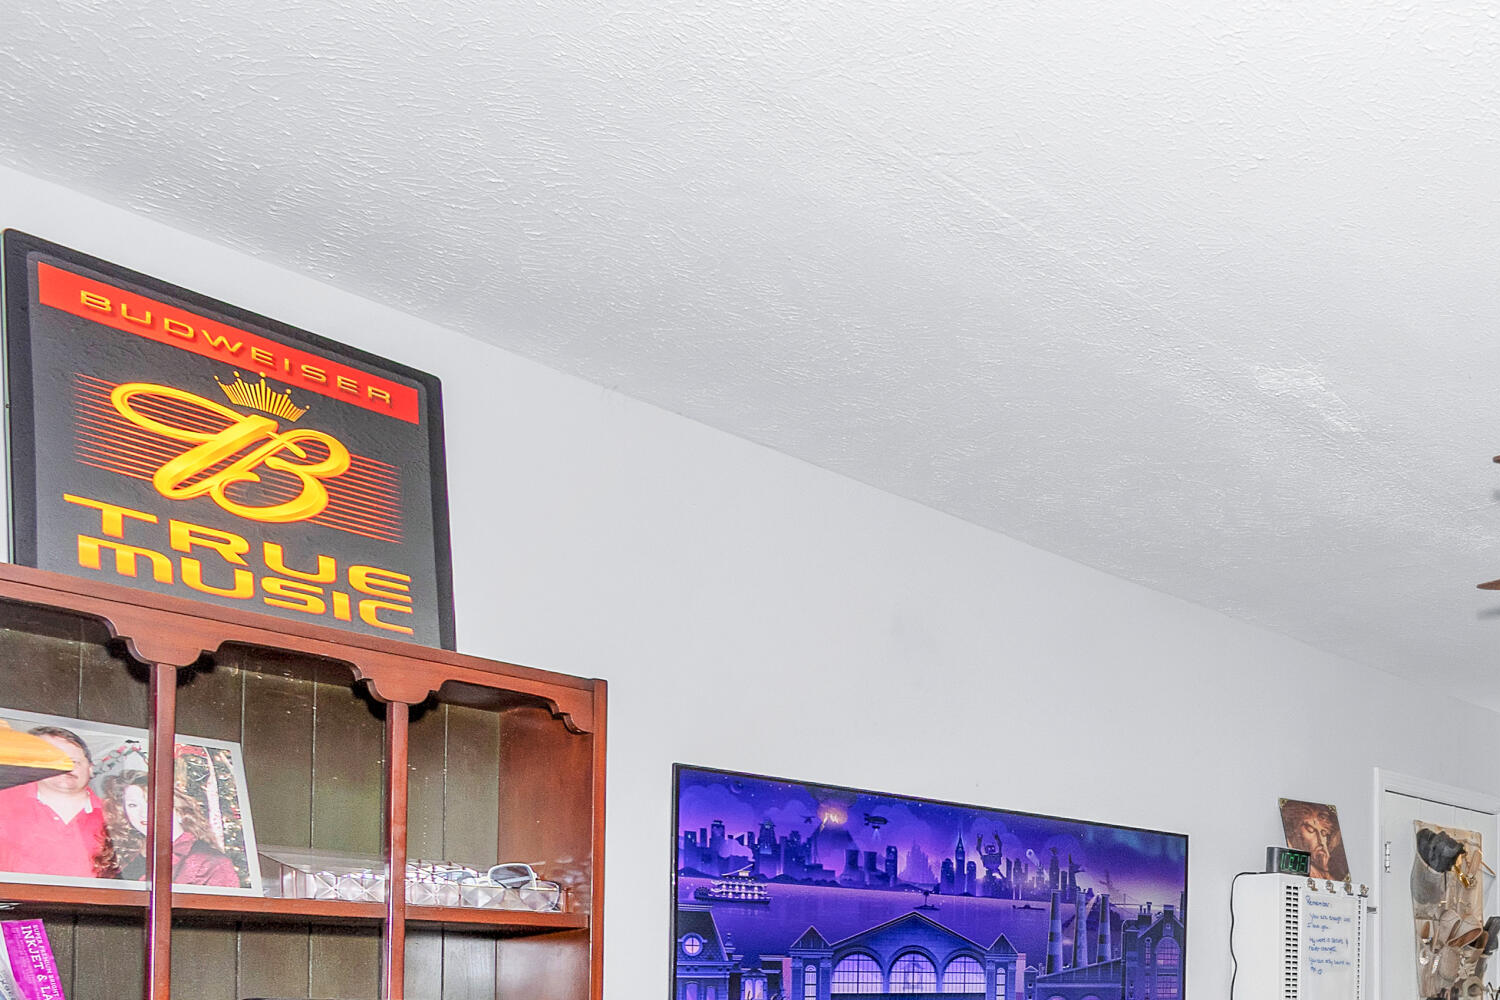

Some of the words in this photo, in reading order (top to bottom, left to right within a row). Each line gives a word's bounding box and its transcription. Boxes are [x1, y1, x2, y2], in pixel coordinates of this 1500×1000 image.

[80, 289, 394, 405] BUDWEISER
[63, 493, 412, 596] TRUE
[21, 925, 44, 970] INKJET
[37, 974, 47, 982] &
